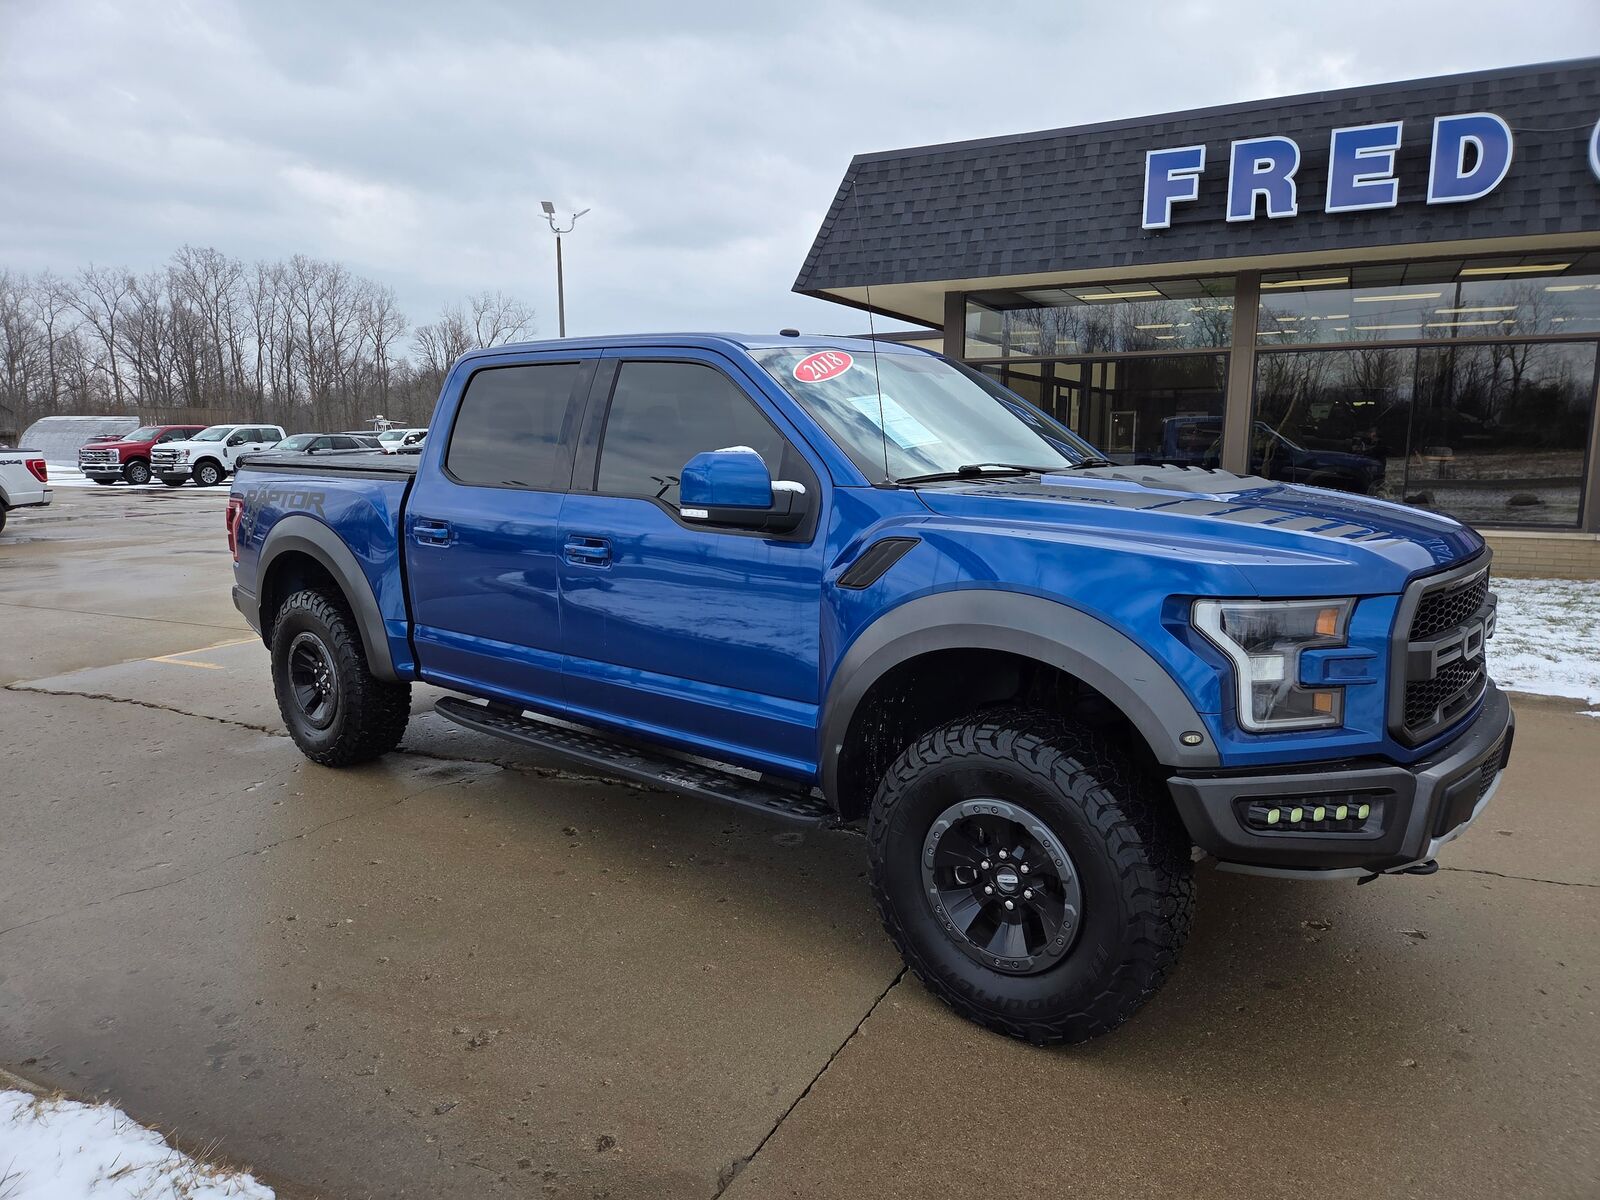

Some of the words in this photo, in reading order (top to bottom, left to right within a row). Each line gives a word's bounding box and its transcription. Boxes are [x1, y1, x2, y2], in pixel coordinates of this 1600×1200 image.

[1142, 112, 1513, 229] FRED
[803, 353, 844, 380] 2018
[245, 489, 327, 520] RAPTOR
